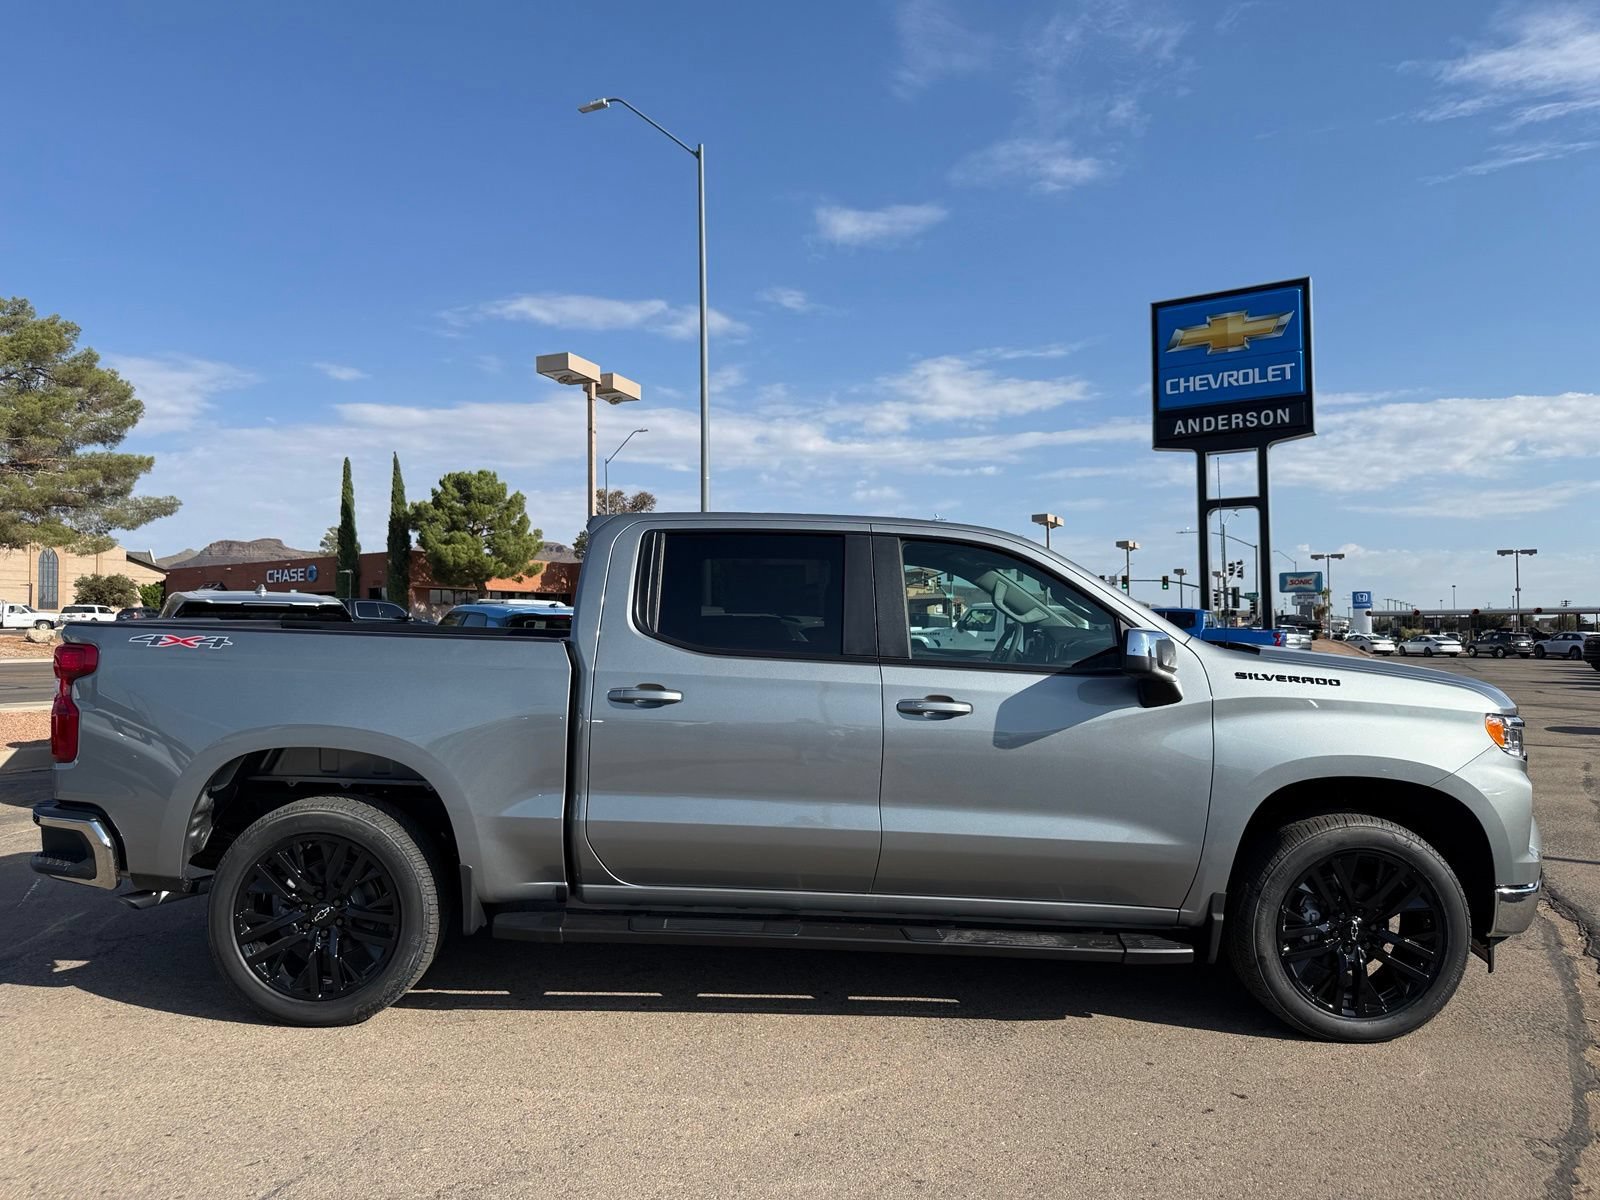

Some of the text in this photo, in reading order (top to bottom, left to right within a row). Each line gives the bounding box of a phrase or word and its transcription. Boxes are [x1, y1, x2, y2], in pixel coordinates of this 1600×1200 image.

[1165, 362, 1295, 395] CHEVROLET
[1173, 408, 1290, 435] ANDERSON
[266, 568, 305, 583] CHASE
[1288, 578, 1312, 586] SONIC
[1234, 672, 1341, 687] SILVERADO
